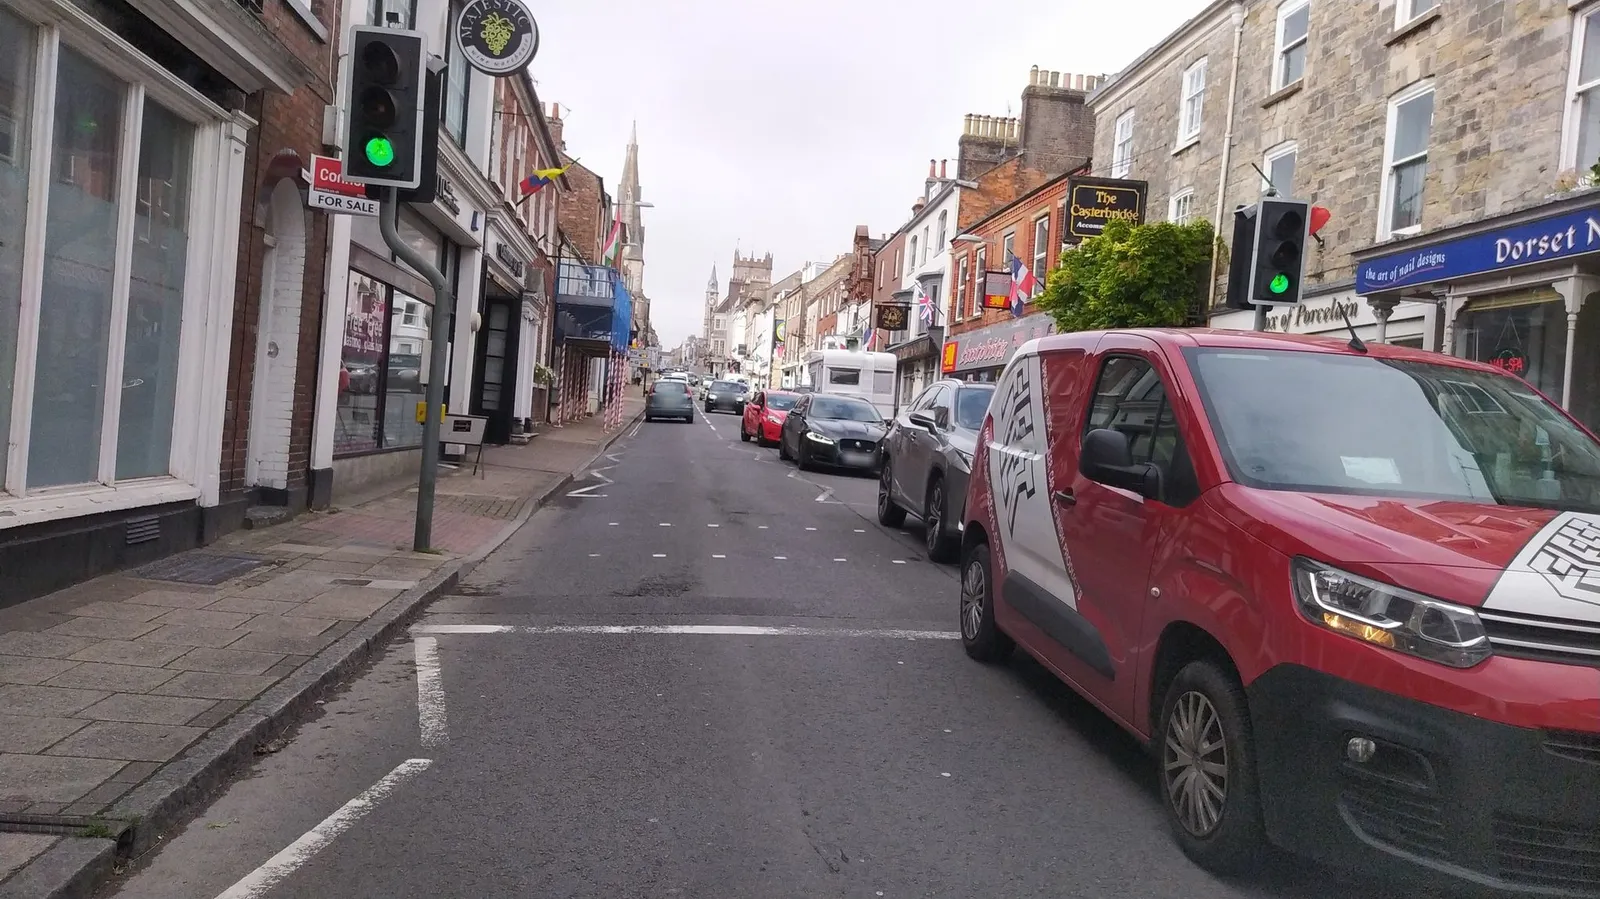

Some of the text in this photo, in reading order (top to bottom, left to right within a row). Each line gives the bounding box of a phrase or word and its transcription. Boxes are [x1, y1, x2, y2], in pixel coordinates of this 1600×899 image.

[461, 0, 529, 39] MAJESTIC
[317, 195, 343, 208] FOR
[346, 200, 375, 213] SALE
[1070, 204, 1140, 223] Casterbridge
[1096, 191, 1117, 206] The
[1494, 225, 1577, 264] Dorset
[1365, 250, 1446, 282] the art of nail designs
[1264, 296, 1359, 332] ox of Porcelain
